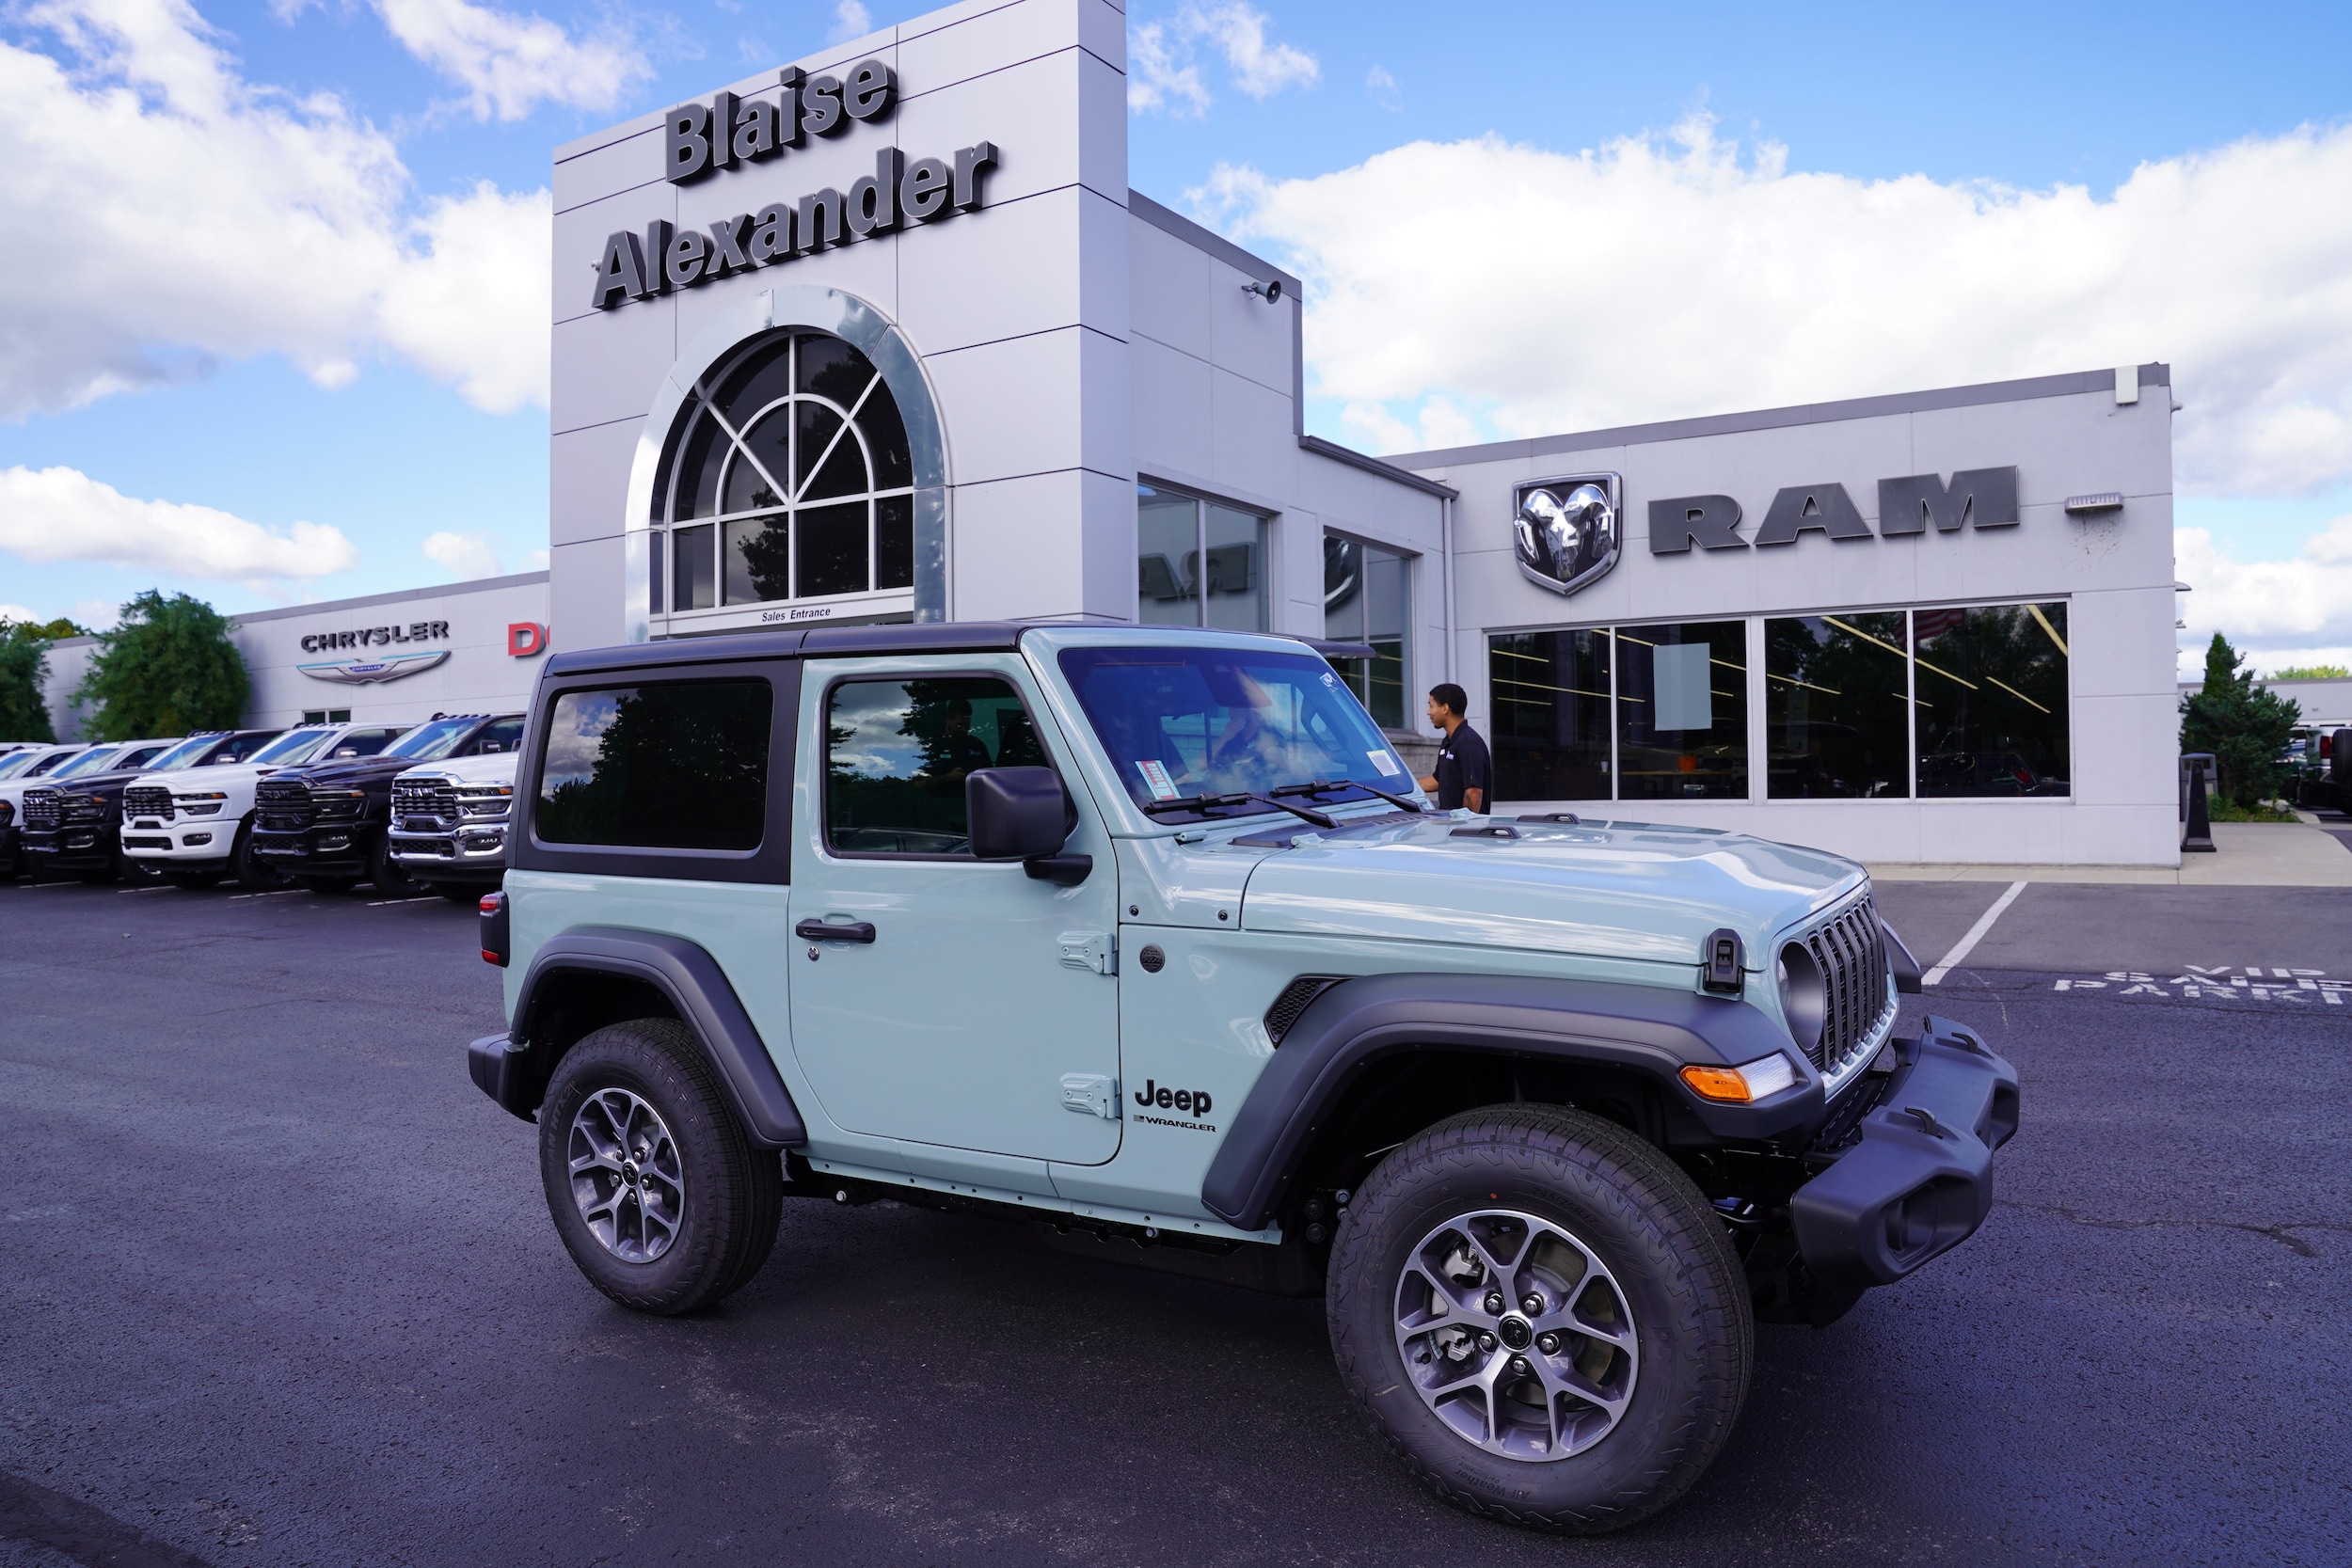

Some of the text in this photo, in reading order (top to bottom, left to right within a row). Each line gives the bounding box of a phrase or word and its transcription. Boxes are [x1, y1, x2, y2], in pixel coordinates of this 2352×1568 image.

[665, 58, 898, 182] Blaise
[592, 140, 998, 309] Alexander
[1647, 465, 2020, 554] RAM
[761, 608, 831, 623] Sales Entrance
[301, 621, 449, 652] CHRYSLER
[508, 622, 550, 658] D
[401, 787, 435, 798] RAM
[1135, 1078, 1212, 1117] Jeep
[1145, 1116, 1216, 1132] WRANGLER
[1530, 1185, 1600, 1225] 245/75R17
[1453, 1468, 1531, 1501] All-Weather
[1458, 1461, 1501, 1483] Performance
